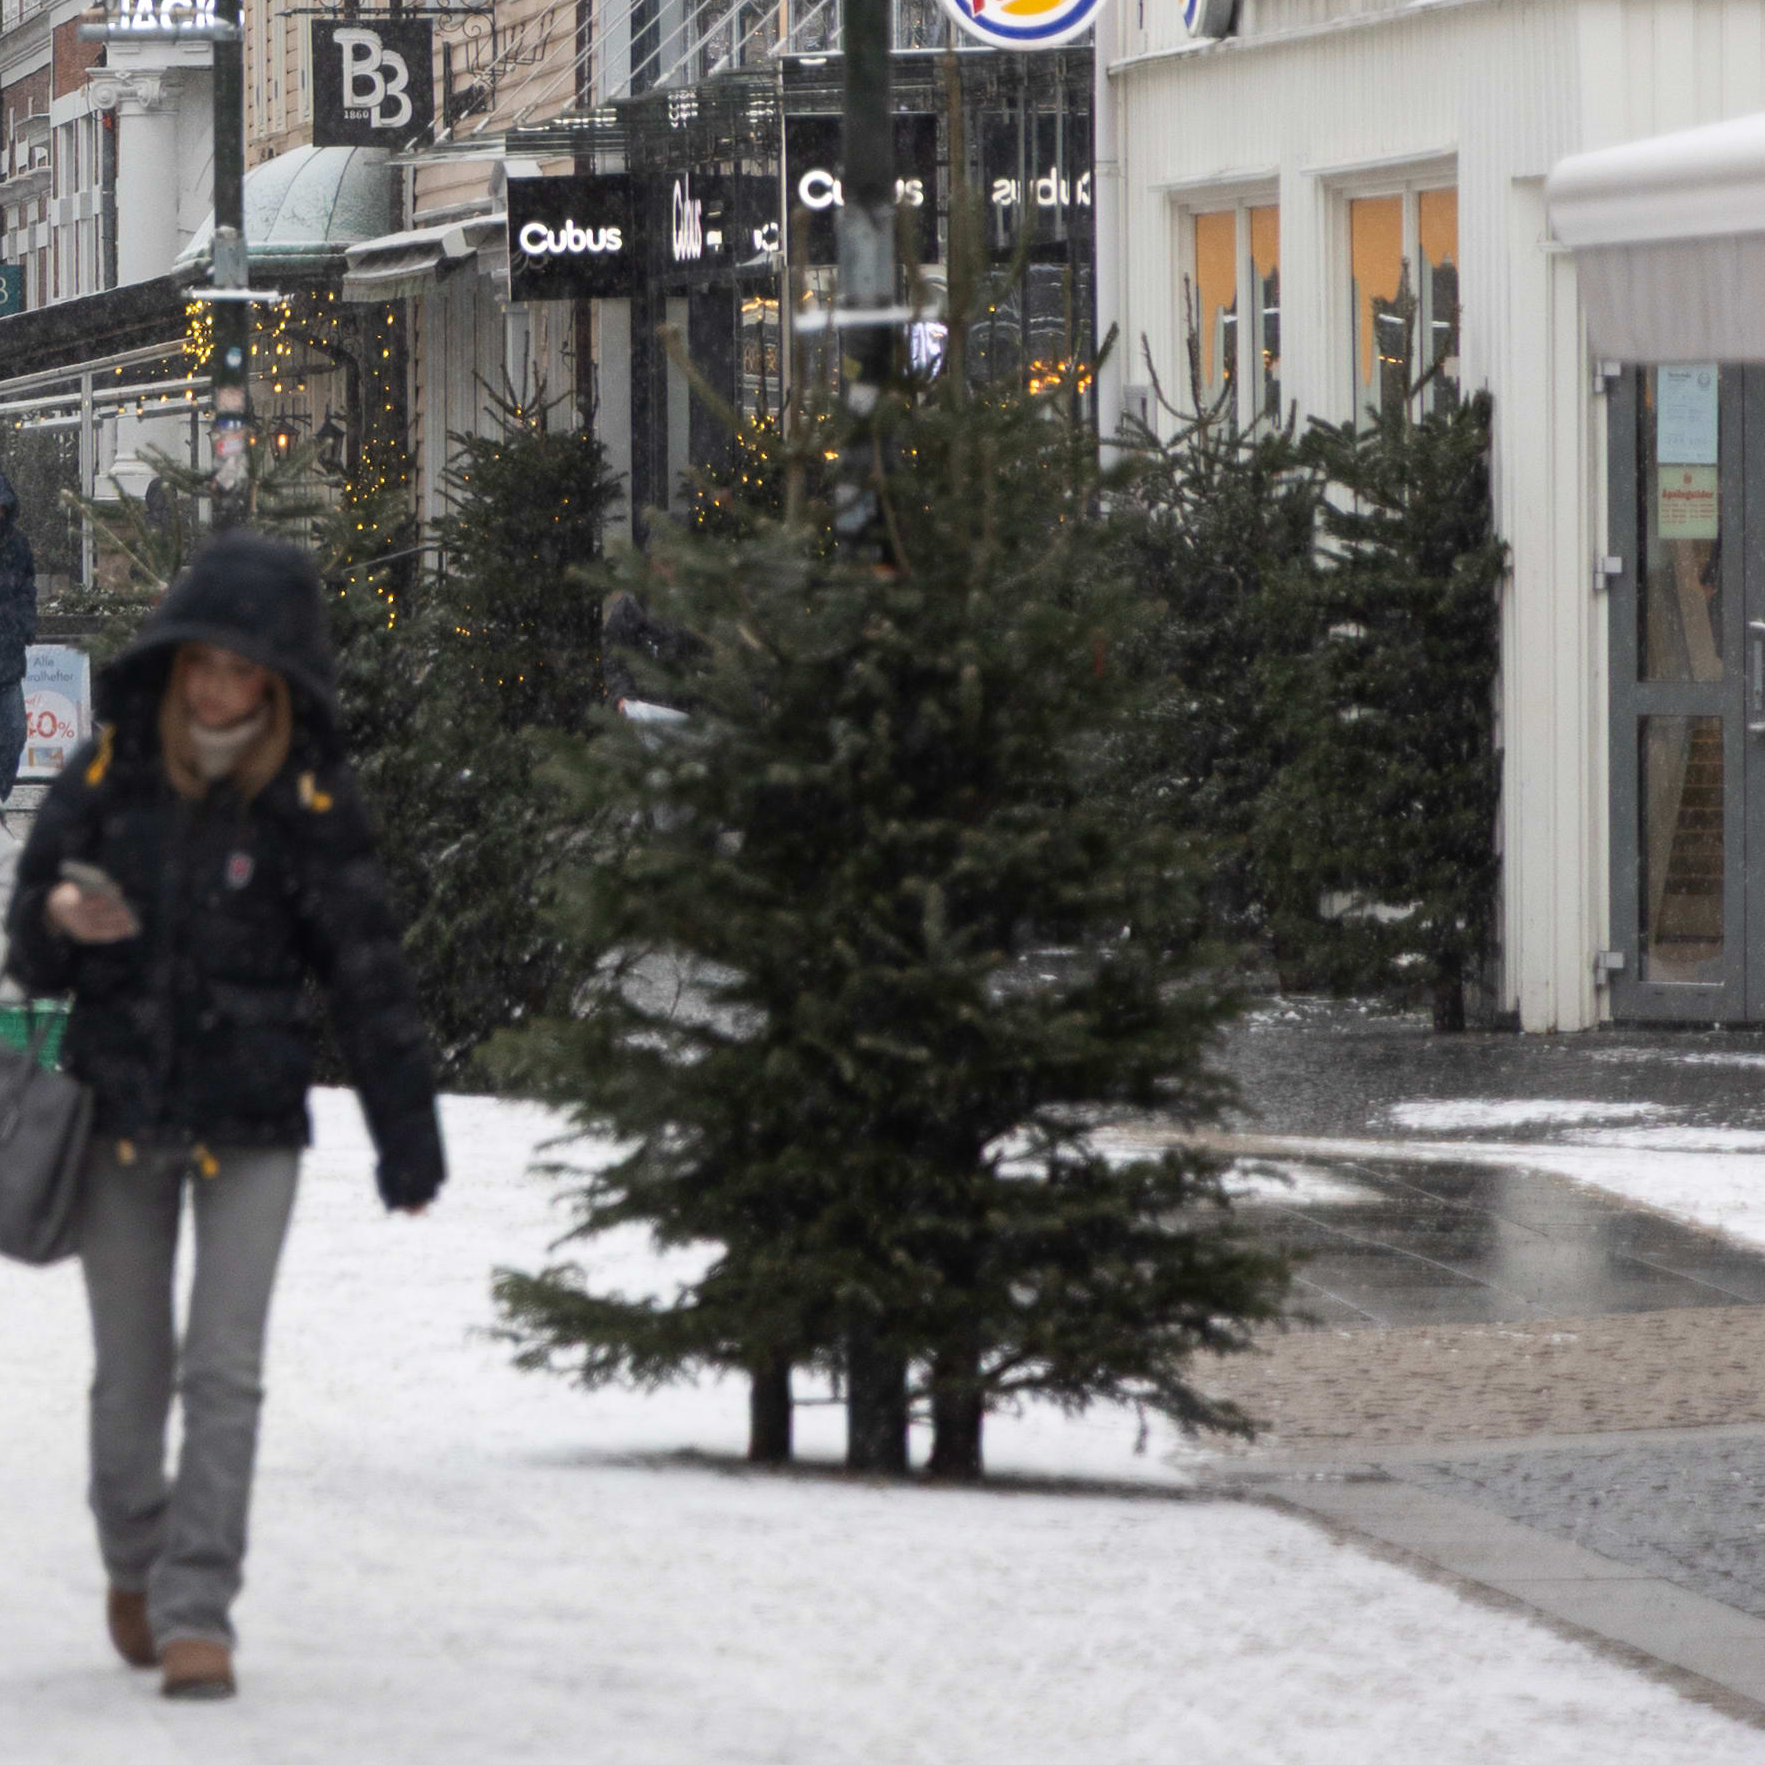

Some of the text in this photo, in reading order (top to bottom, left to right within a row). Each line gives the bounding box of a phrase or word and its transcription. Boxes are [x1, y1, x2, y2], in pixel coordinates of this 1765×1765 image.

[343, 109, 370, 120] 1860
[519, 219, 623, 255] Cubus
[33, 657, 55, 667] Alle
